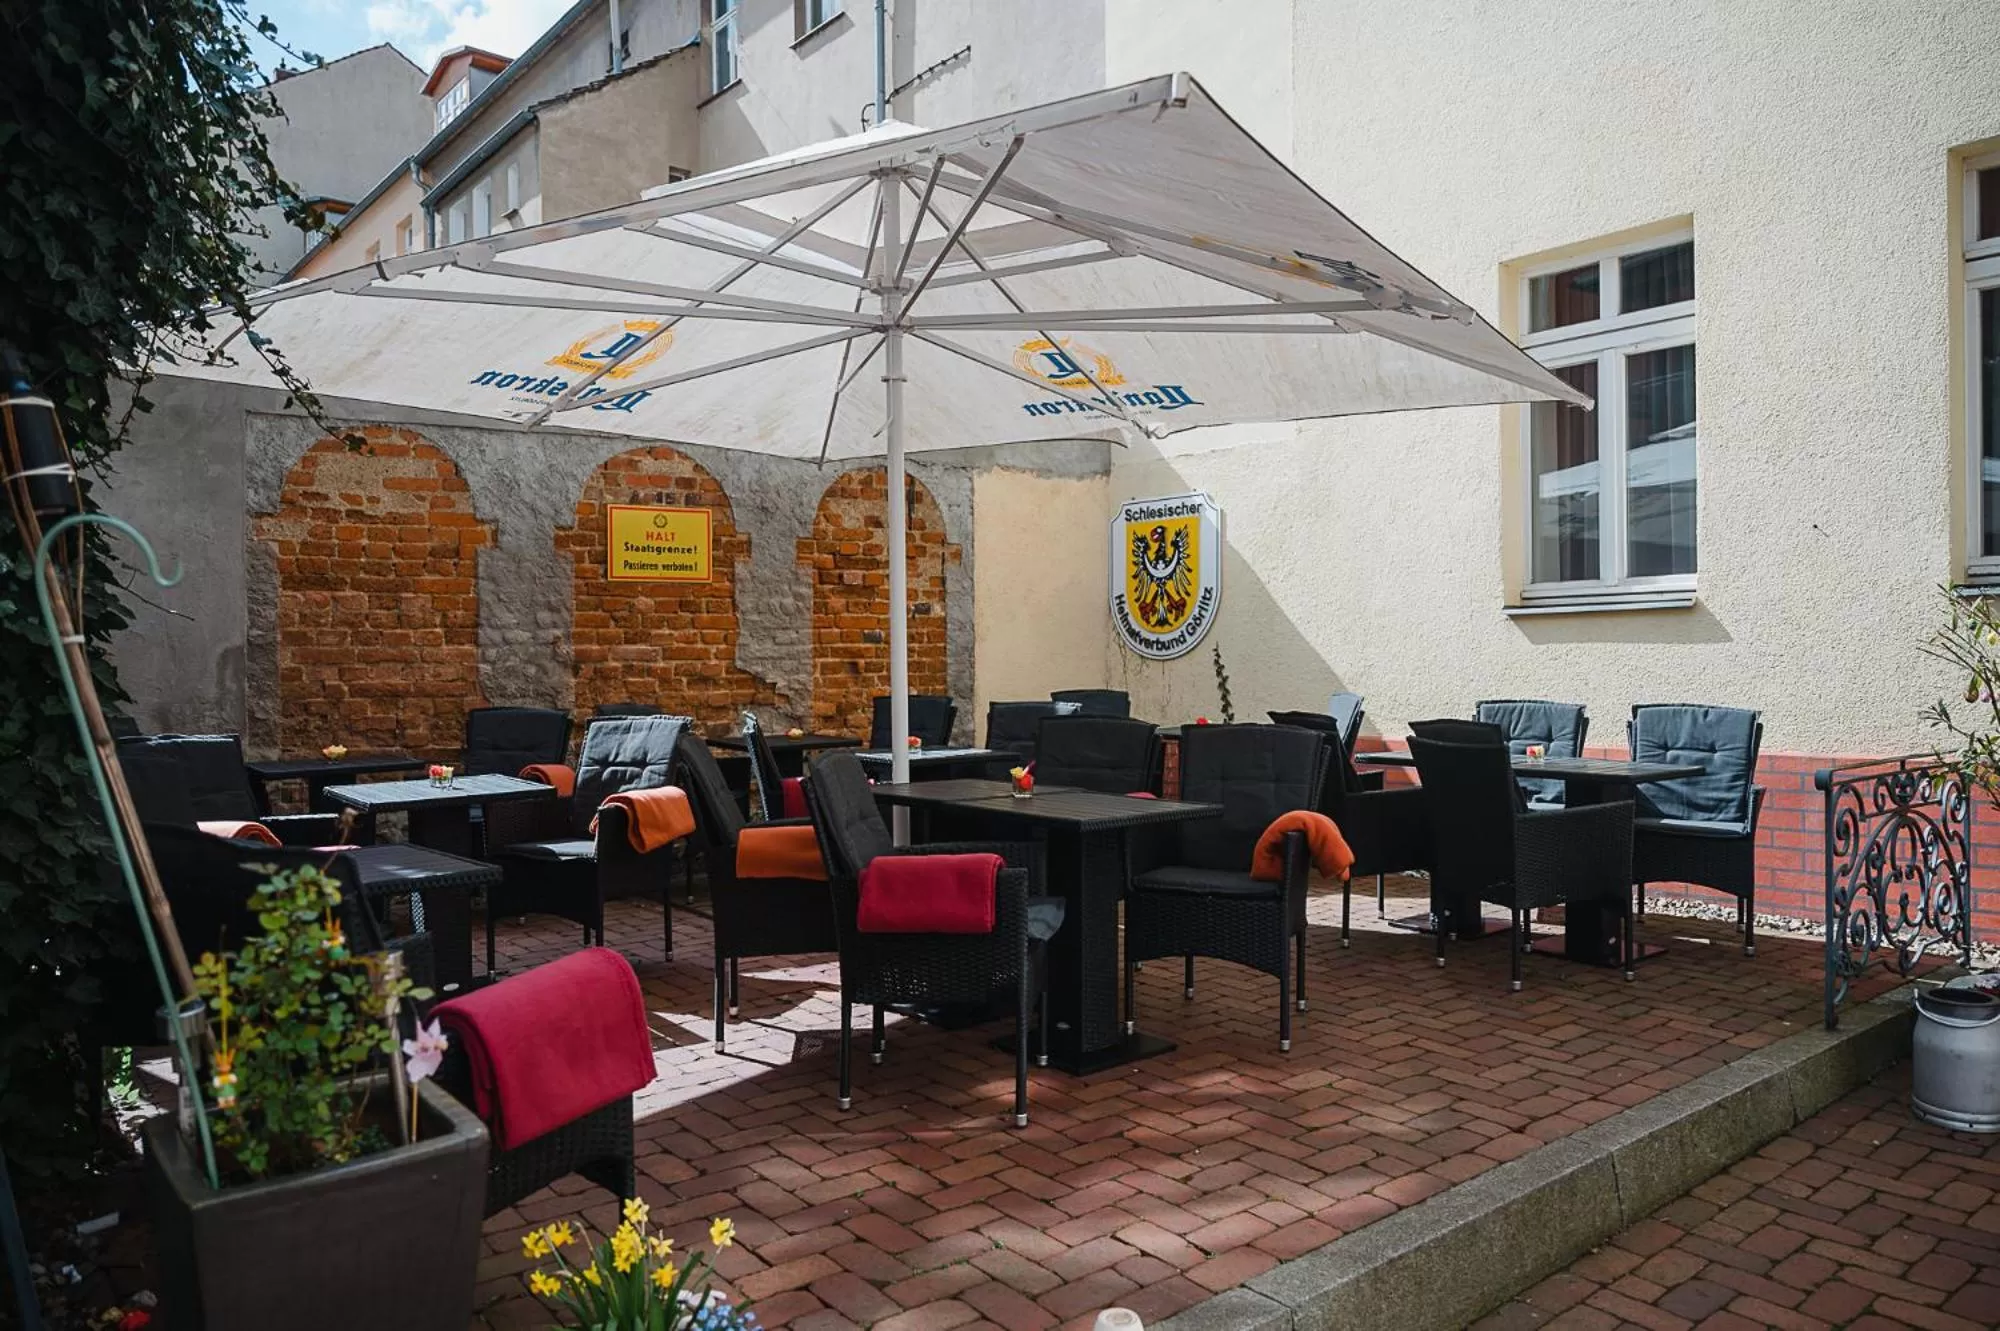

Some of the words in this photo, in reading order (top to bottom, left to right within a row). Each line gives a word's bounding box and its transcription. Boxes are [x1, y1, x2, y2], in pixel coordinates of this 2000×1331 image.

[1124, 502, 1202, 522] Schlesischer
[645, 531, 676, 542] HALT
[623, 541, 698, 555] Staatsgrenze!
[623, 559, 659, 571] Passieren
[662, 561, 698, 572] verboten!
[1114, 594, 1188, 651] Heimatverbund
[1187, 586, 1214, 637] Görlitz
